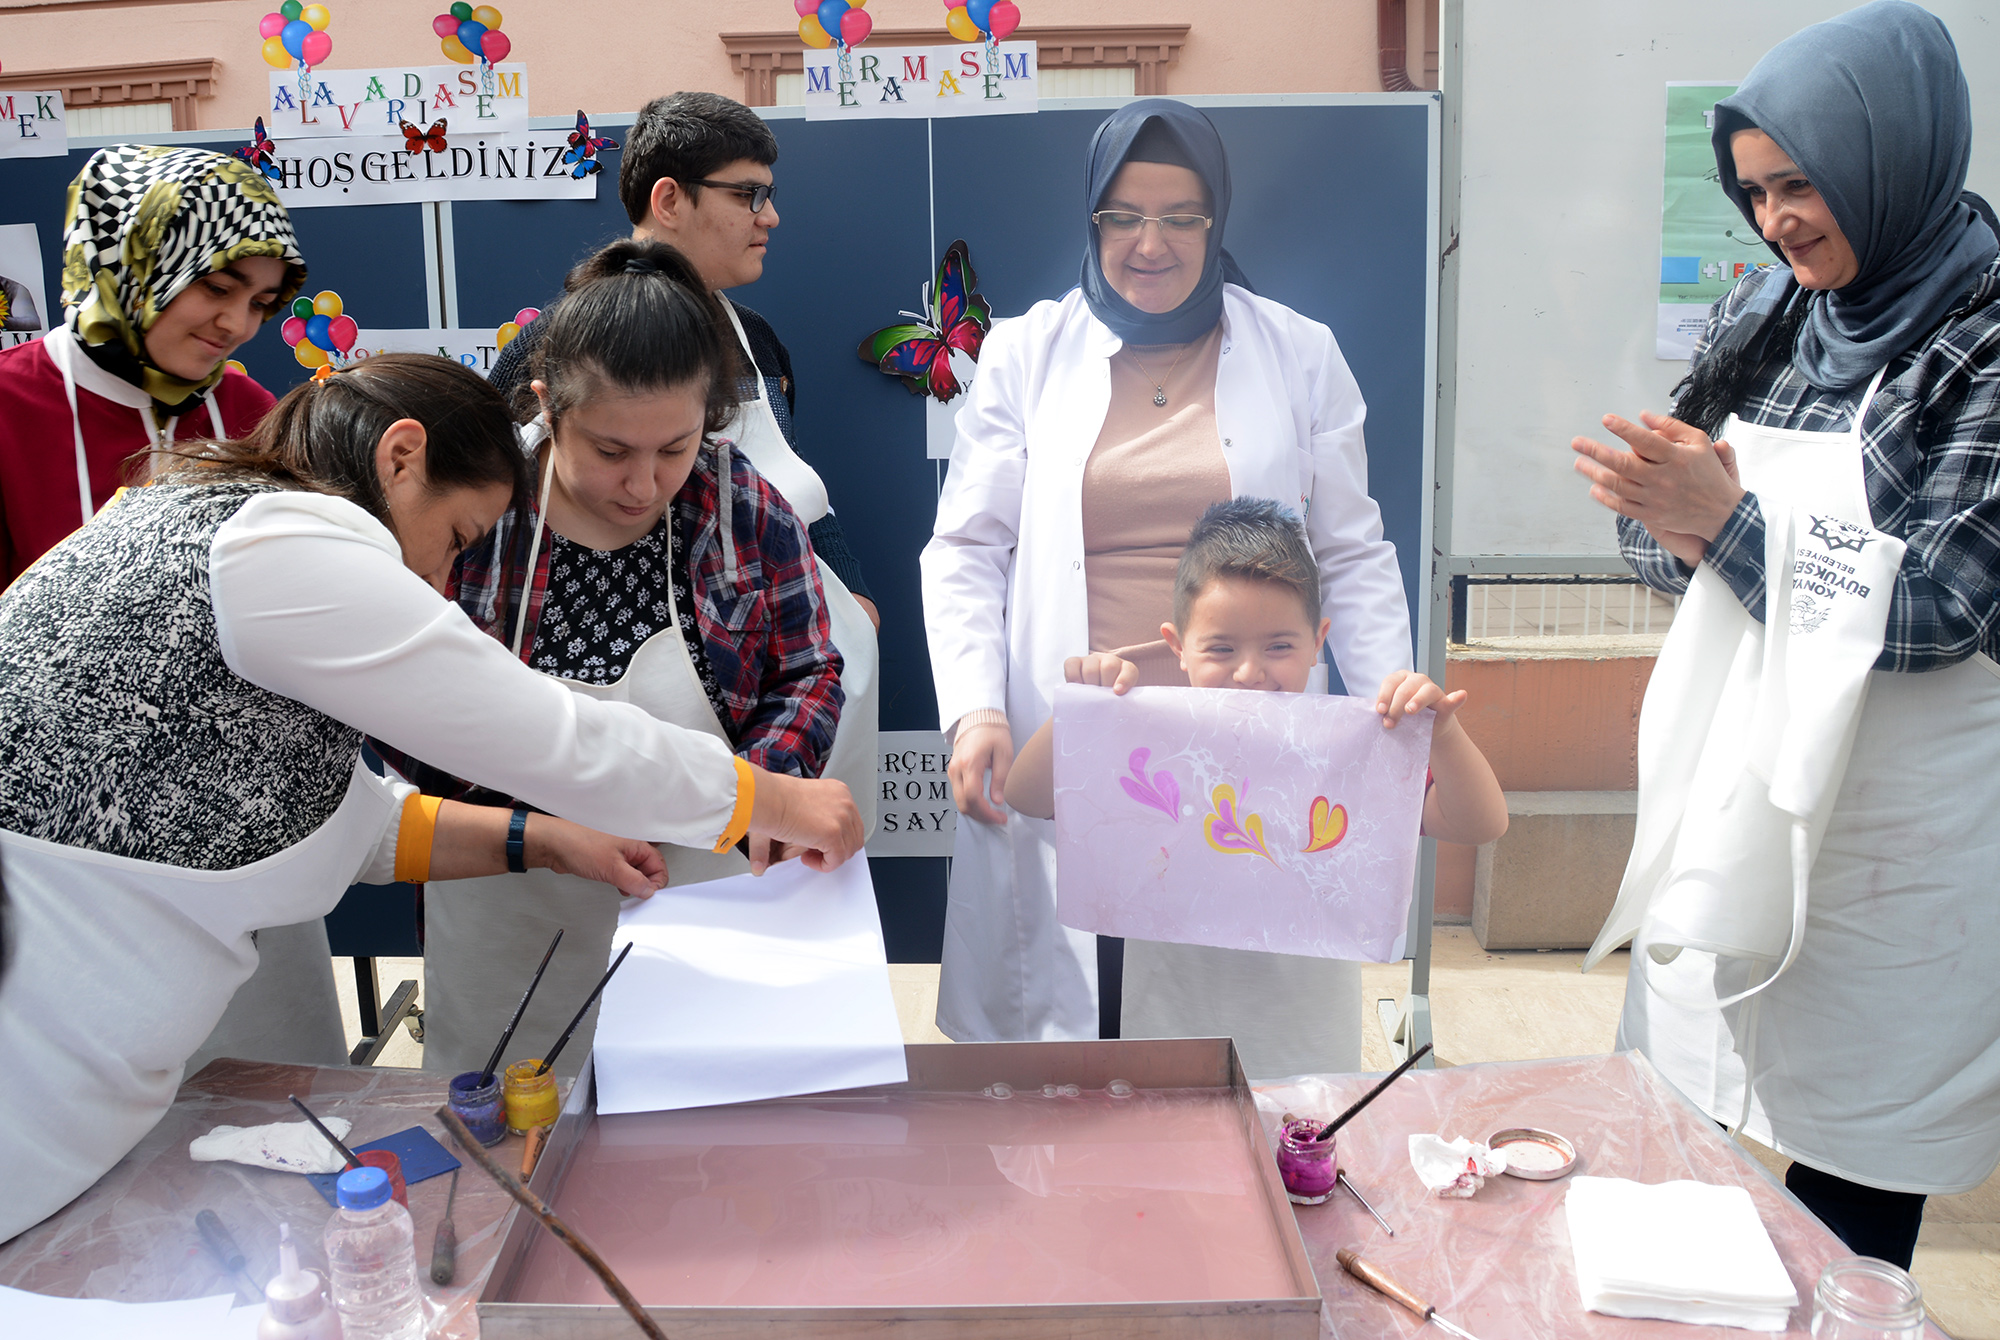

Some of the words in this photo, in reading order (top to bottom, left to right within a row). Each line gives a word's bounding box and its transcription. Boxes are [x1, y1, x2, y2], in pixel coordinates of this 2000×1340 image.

[806, 55, 929, 107] MERAM
[937, 51, 1029, 99] ASEM
[432, 70, 522, 119] ASEM
[279, 140, 568, 193] HOŞGELDİNİZ
[1733, 262, 1769, 278] FA
[878, 750, 953, 775] RÇEK
[878, 780, 947, 801] ROM
[882, 808, 957, 832] SAY
